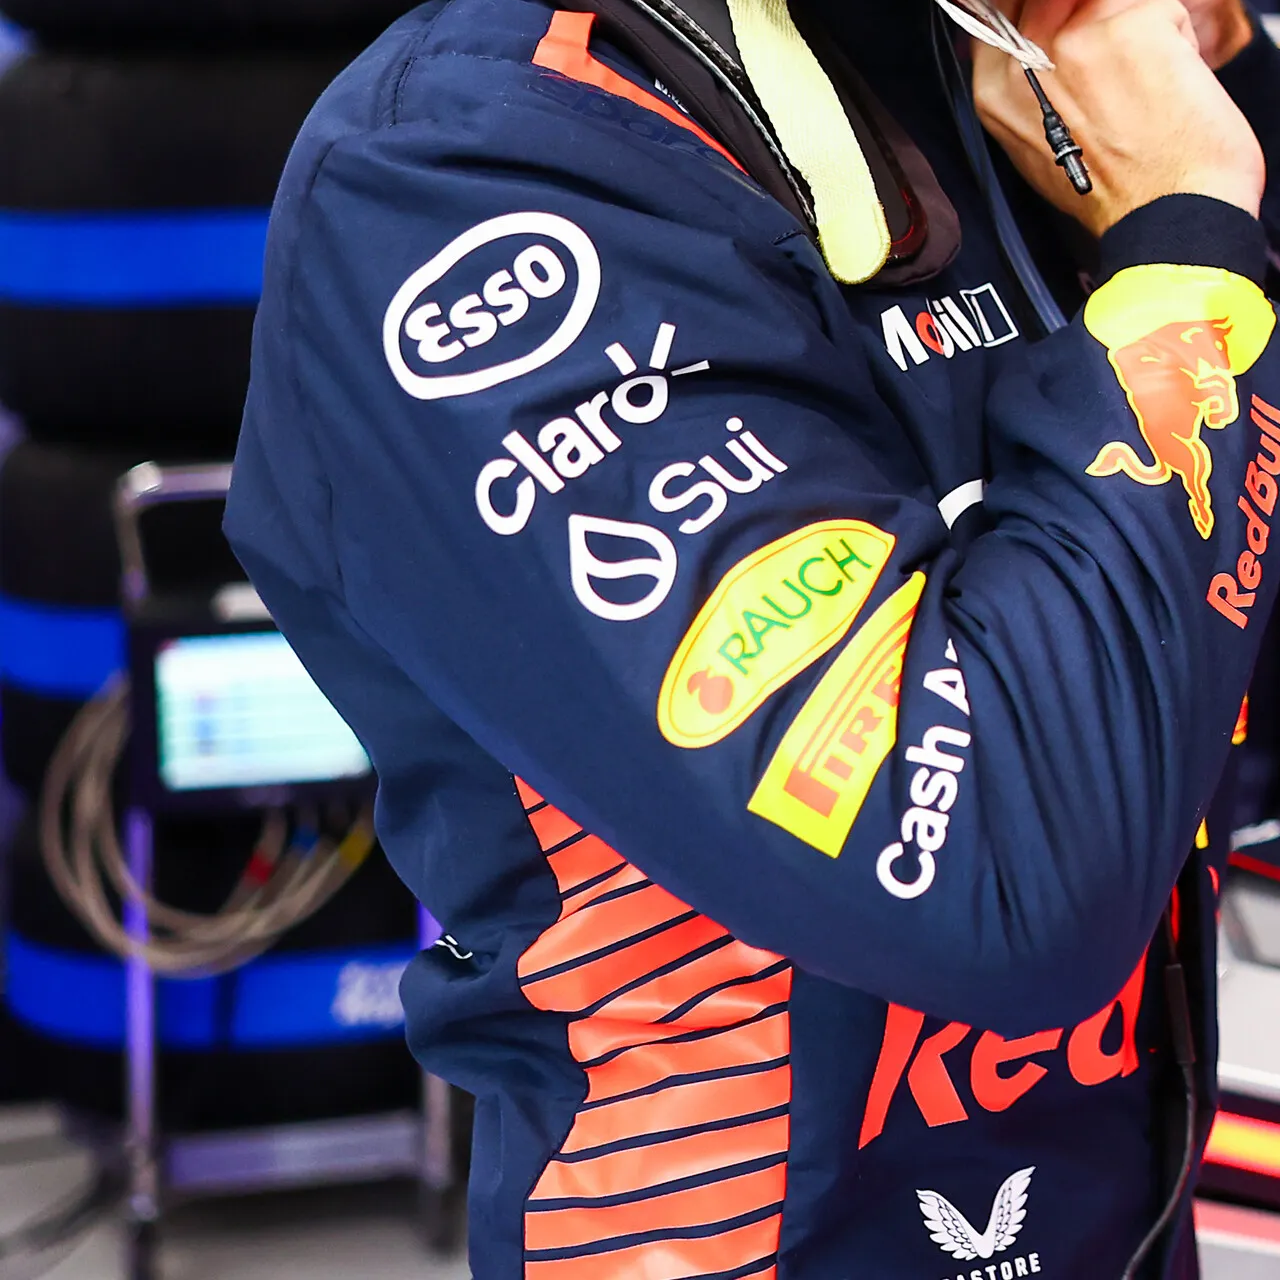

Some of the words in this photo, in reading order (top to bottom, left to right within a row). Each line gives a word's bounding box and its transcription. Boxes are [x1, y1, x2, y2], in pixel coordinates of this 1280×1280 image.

[404, 244, 566, 363] Esso
[475, 375, 669, 535] Claro
[648, 417, 788, 534] Sui
[717, 538, 873, 676] RAUCH
[876, 725, 971, 899] Cash
